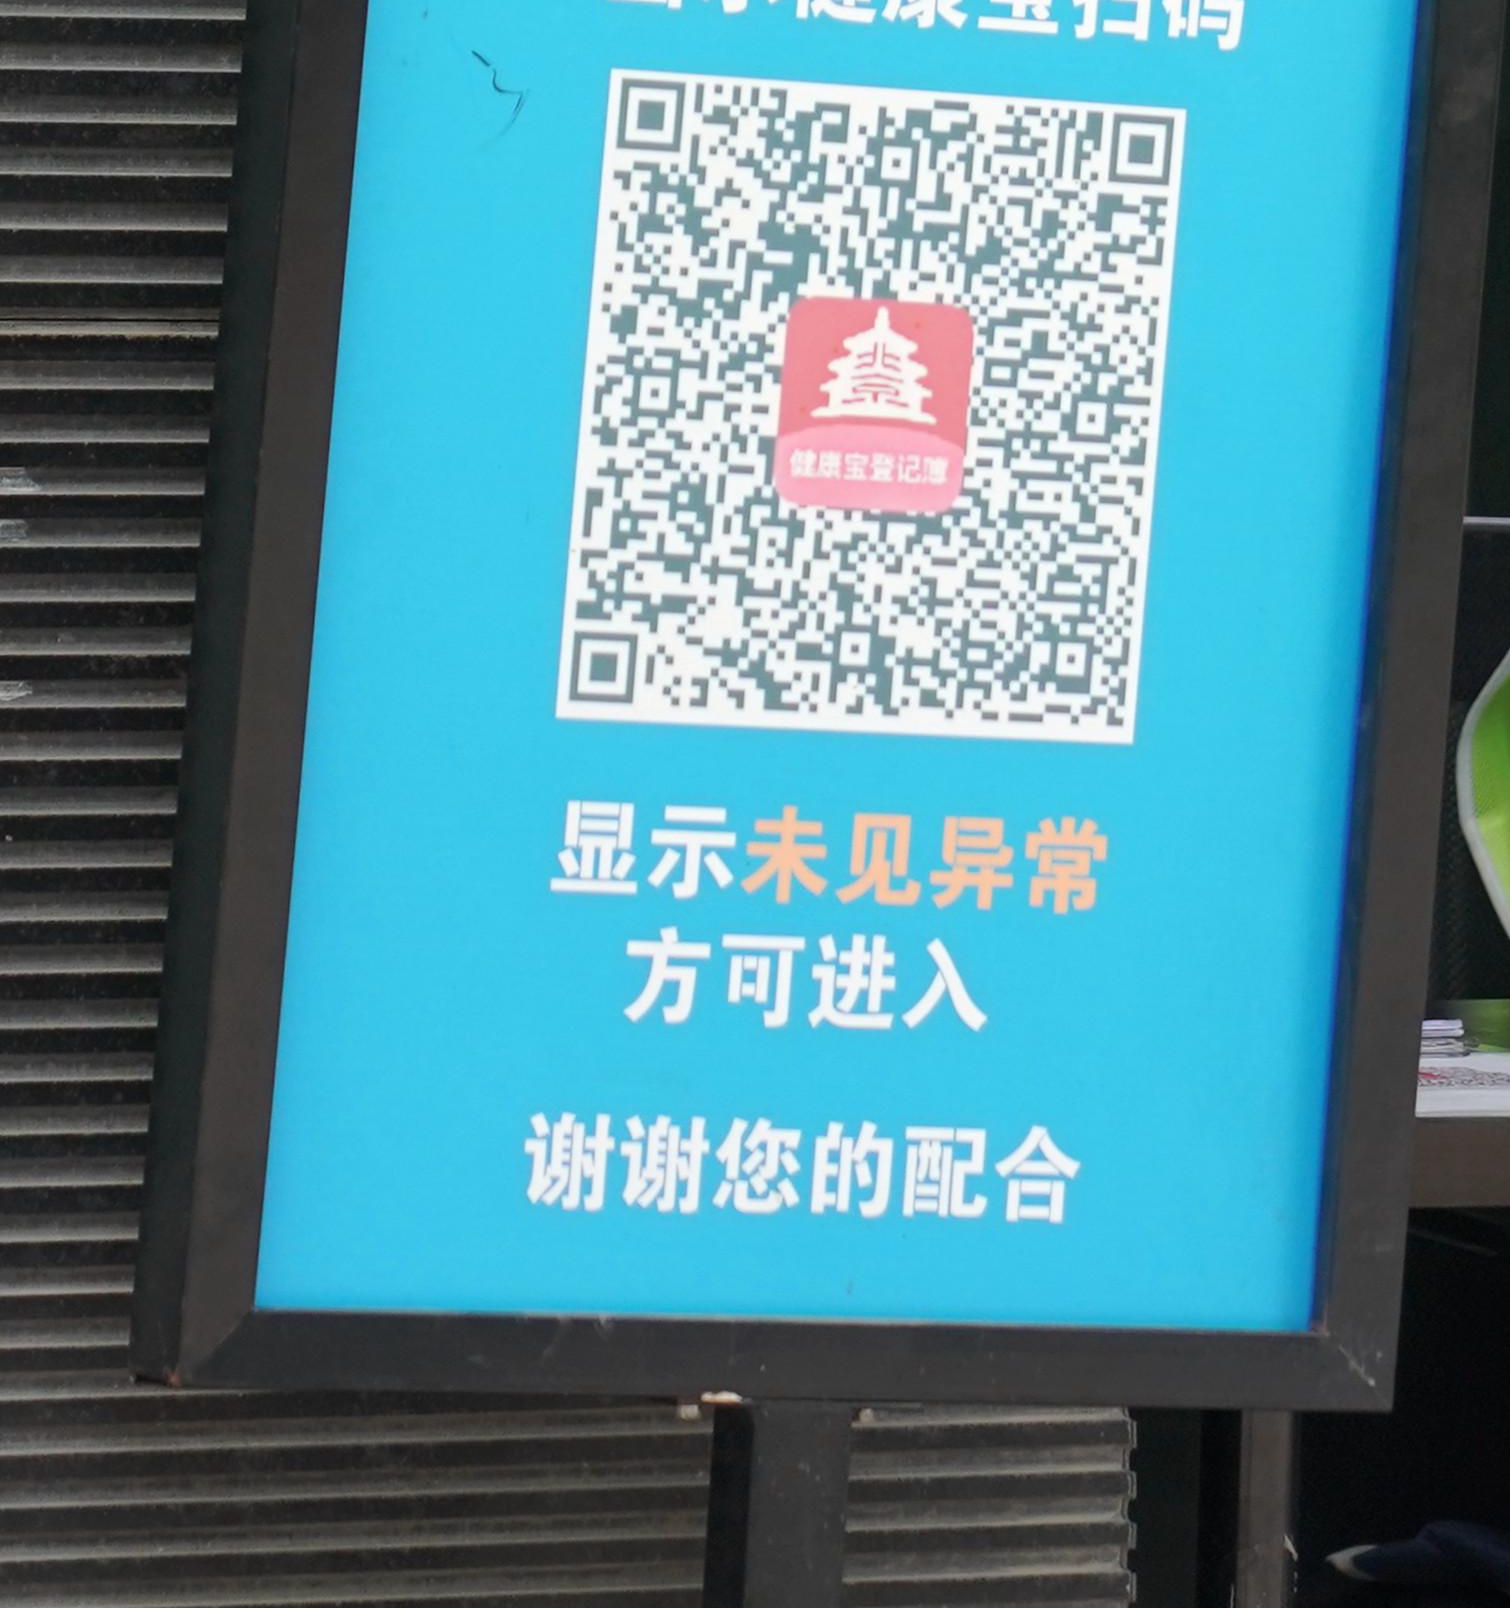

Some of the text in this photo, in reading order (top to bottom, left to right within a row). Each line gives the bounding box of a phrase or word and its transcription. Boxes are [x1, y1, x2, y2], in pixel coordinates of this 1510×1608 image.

[550, 799, 1109, 915] 显示未见异常
[623, 926, 988, 1033] 方可进入
[525, 1112, 1081, 1225] 谢谢您的配合
